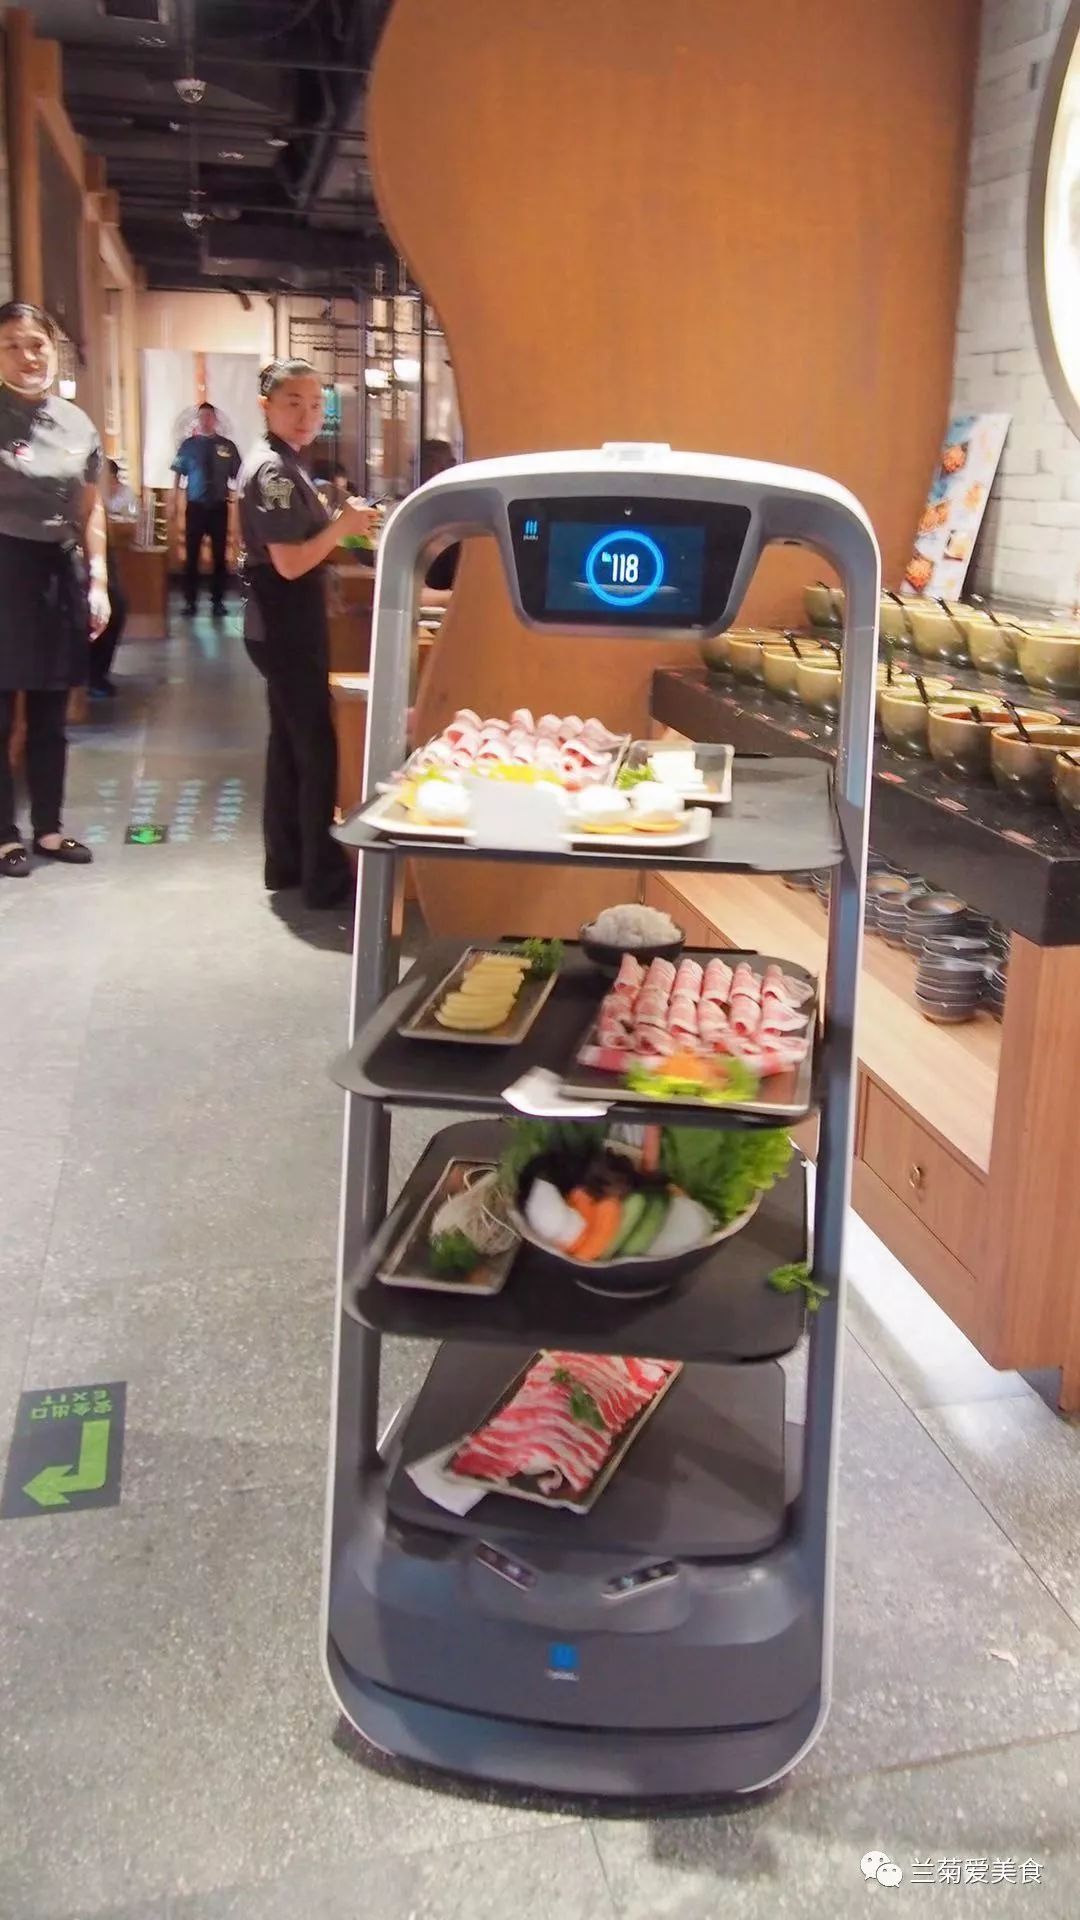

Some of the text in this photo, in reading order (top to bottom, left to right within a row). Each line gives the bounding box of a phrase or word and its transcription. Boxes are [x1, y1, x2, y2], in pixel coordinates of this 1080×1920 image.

[41, 1390, 107, 1405] EXIT
[31, 1400, 112, 1419] 安全出口
